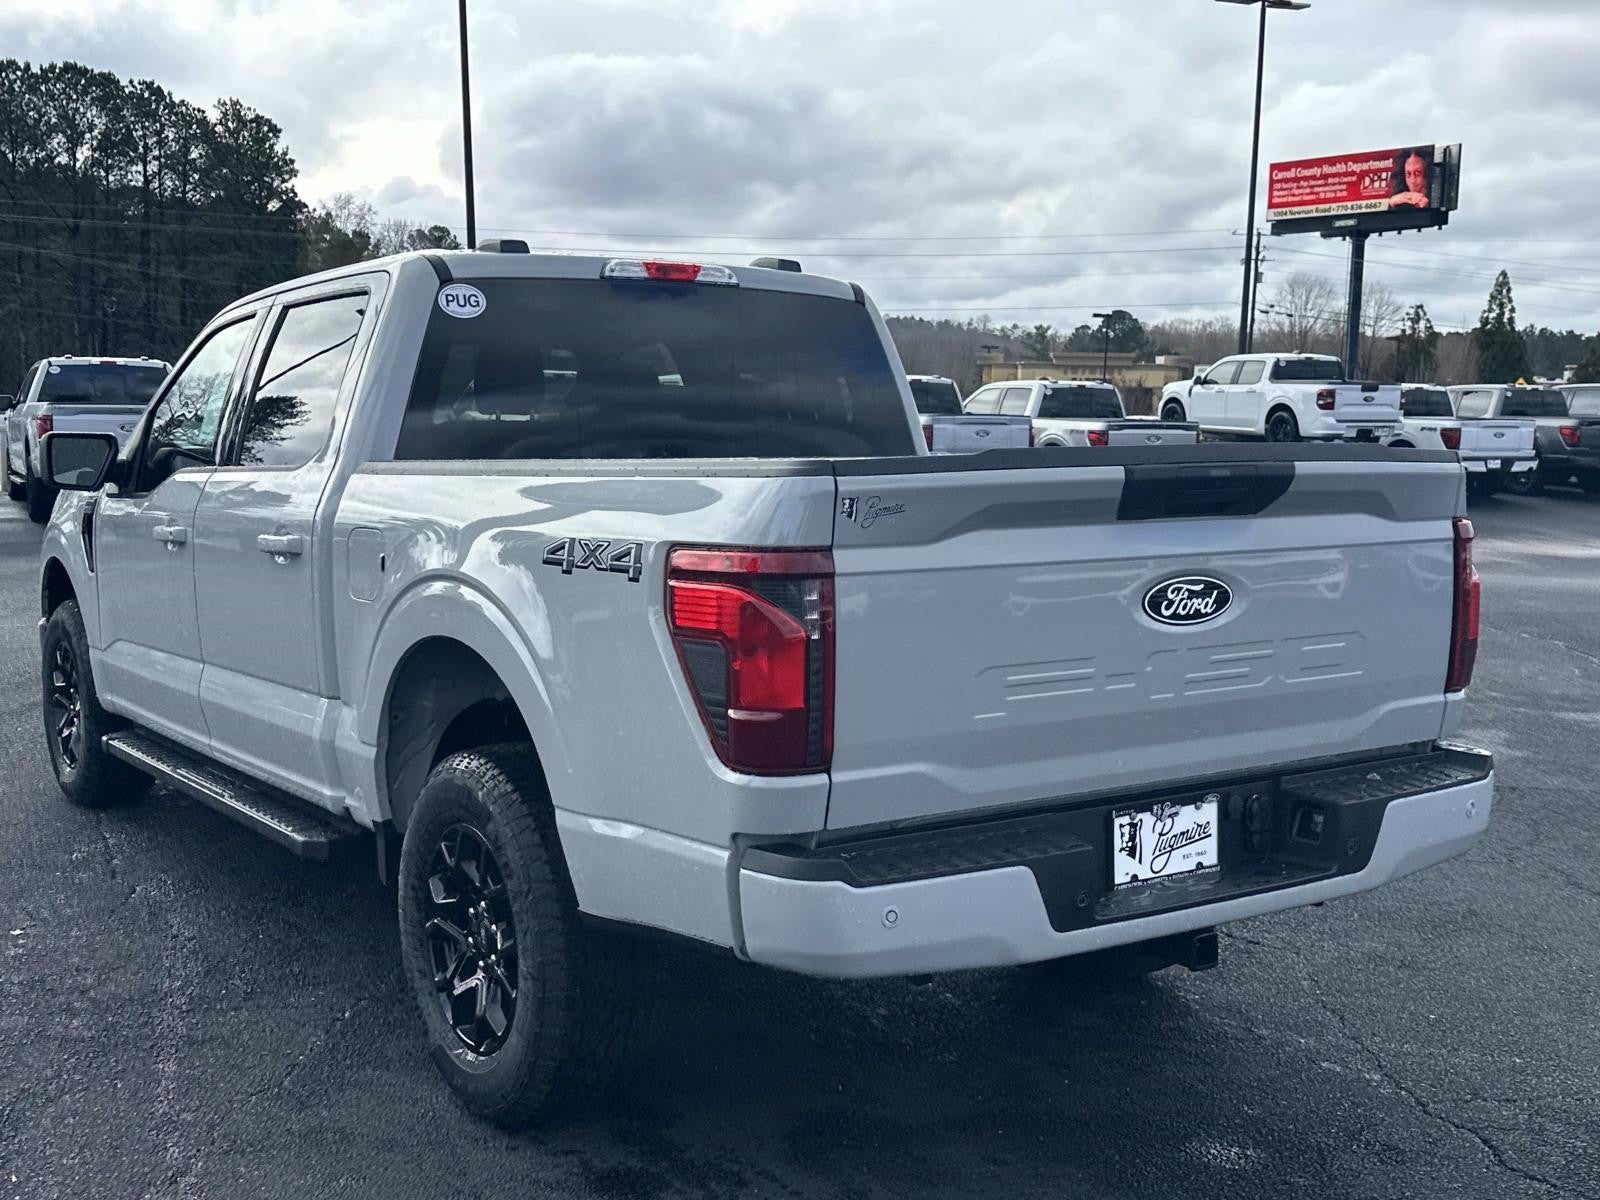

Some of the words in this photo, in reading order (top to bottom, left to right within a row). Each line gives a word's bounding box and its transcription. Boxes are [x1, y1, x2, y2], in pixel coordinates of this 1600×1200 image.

[1273, 168, 1296, 180] Carroll
[1297, 167, 1321, 178] County
[1322, 162, 1346, 175] Health
[1347, 158, 1393, 174] Department
[1289, 208, 1313, 216] Newman
[1314, 205, 1332, 214] Road
[445, 293, 481, 308] PUG
[1161, 584, 1218, 616] Ford
[1150, 815, 1212, 875] Pugmire
